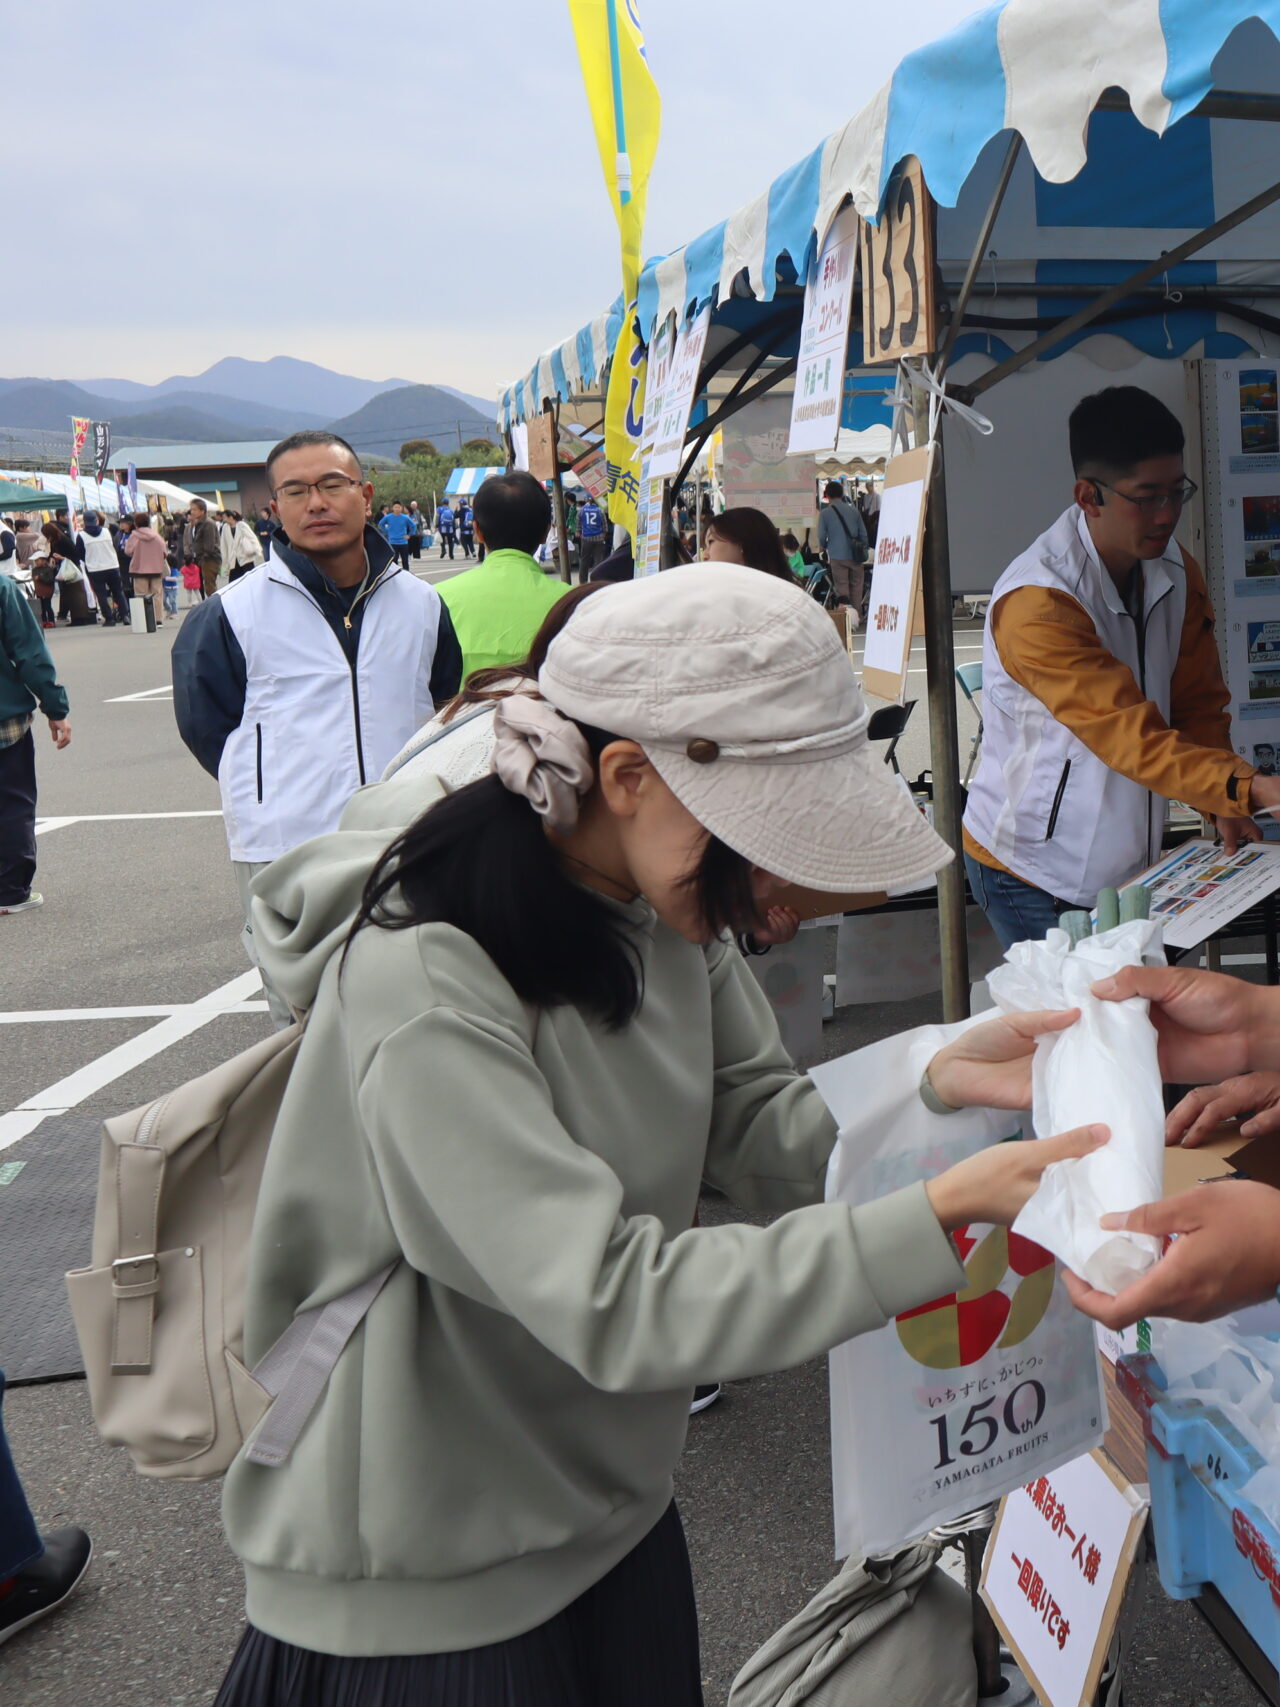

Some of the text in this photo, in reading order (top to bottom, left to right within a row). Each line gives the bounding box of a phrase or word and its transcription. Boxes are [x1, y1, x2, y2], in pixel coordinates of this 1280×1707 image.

[585, 512, 598, 525] 12
[935, 1432, 1049, 1489] YAMAGATA FRUITS
[1011, 1551, 1071, 1650] 一回限りです
